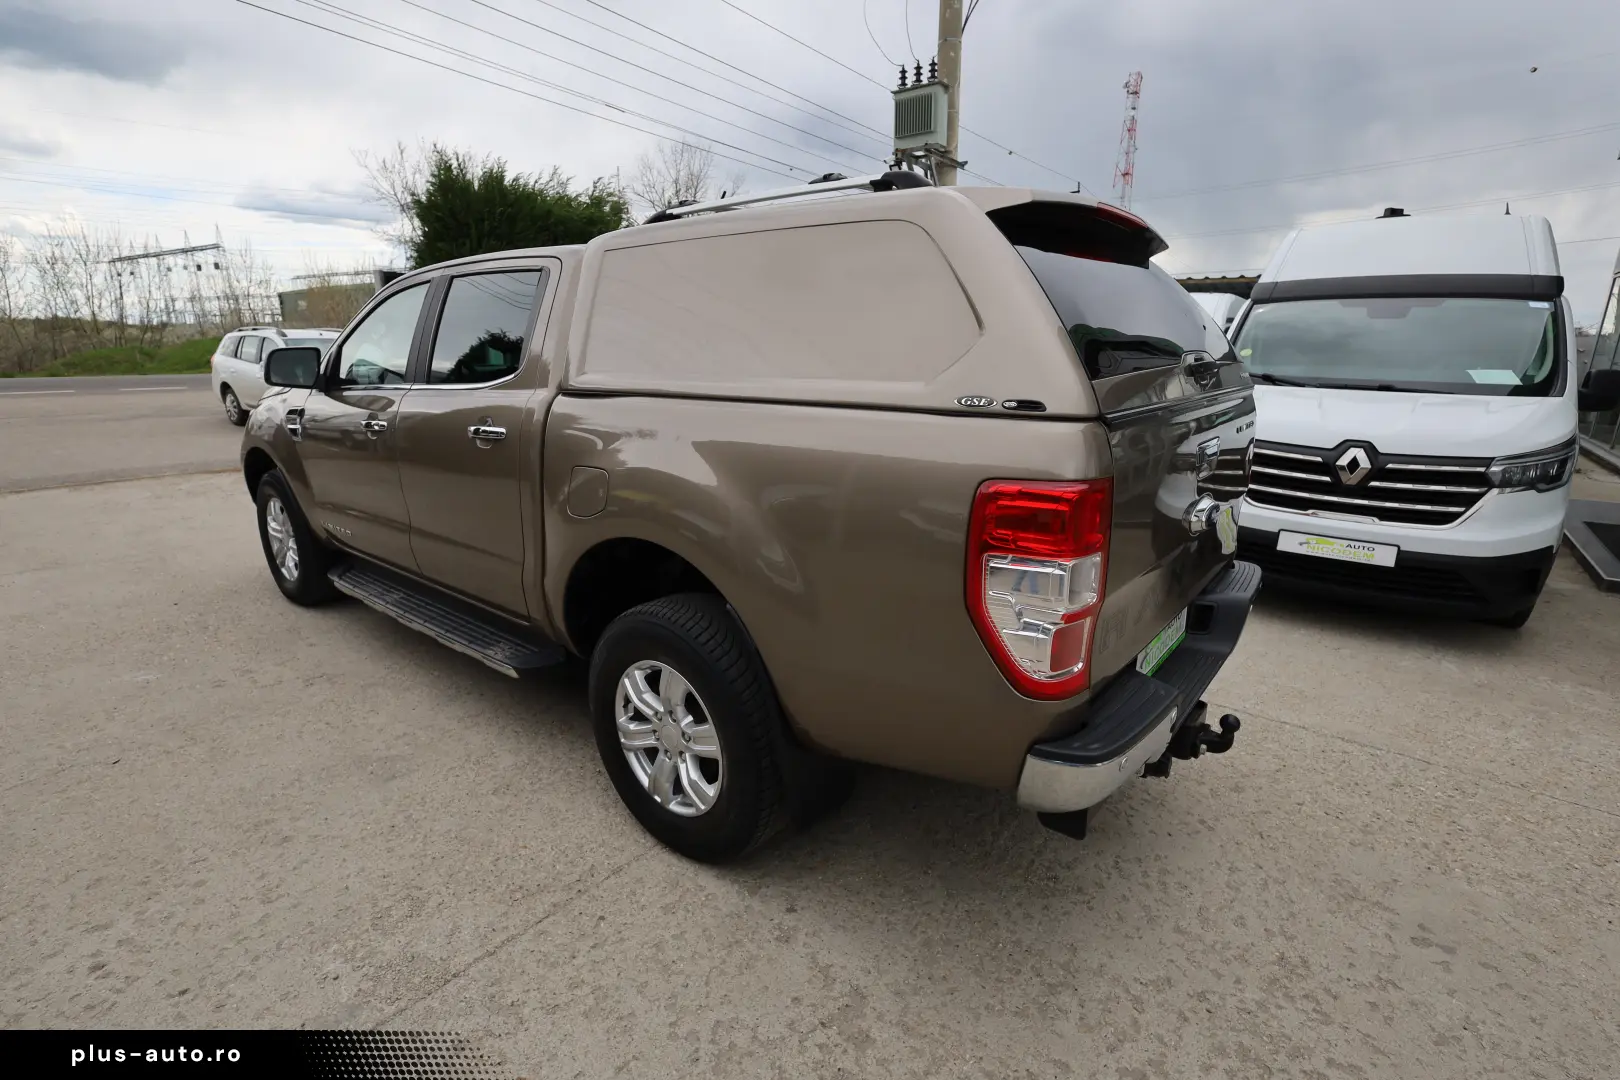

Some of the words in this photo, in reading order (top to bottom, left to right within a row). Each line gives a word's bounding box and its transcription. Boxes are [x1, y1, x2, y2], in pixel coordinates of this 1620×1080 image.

[961, 397, 990, 406] GSE
[1306, 544, 1375, 559] NICODEM
[1345, 543, 1375, 552] AUTO
